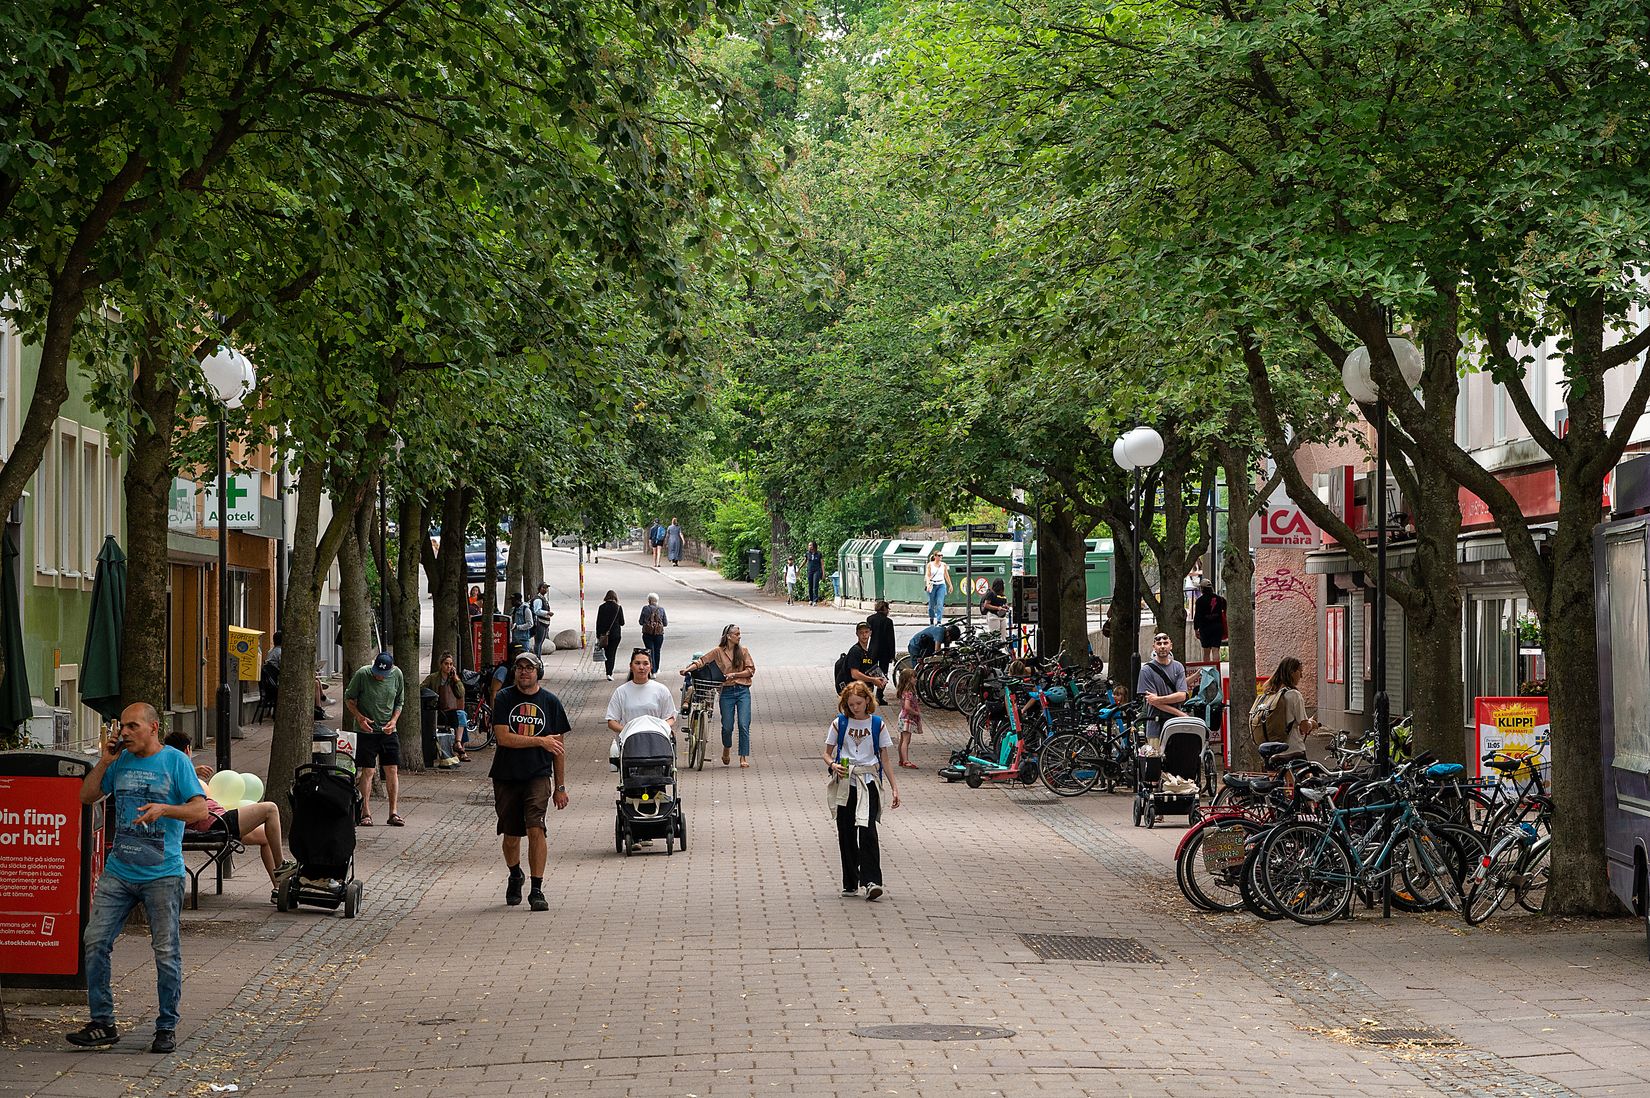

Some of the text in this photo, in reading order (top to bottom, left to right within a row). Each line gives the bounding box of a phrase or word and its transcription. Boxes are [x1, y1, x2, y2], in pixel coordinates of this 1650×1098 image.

[208, 511, 255, 522] Aotek
[1261, 508, 1312, 536] ICA
[1284, 535, 1312, 545] nära
[511, 715, 544, 725] TOYOTA
[1498, 717, 1533, 728] KLIPP!
[0, 808, 20, 825] in
[23, 808, 67, 830] fimp
[23, 829, 60, 846] här!
